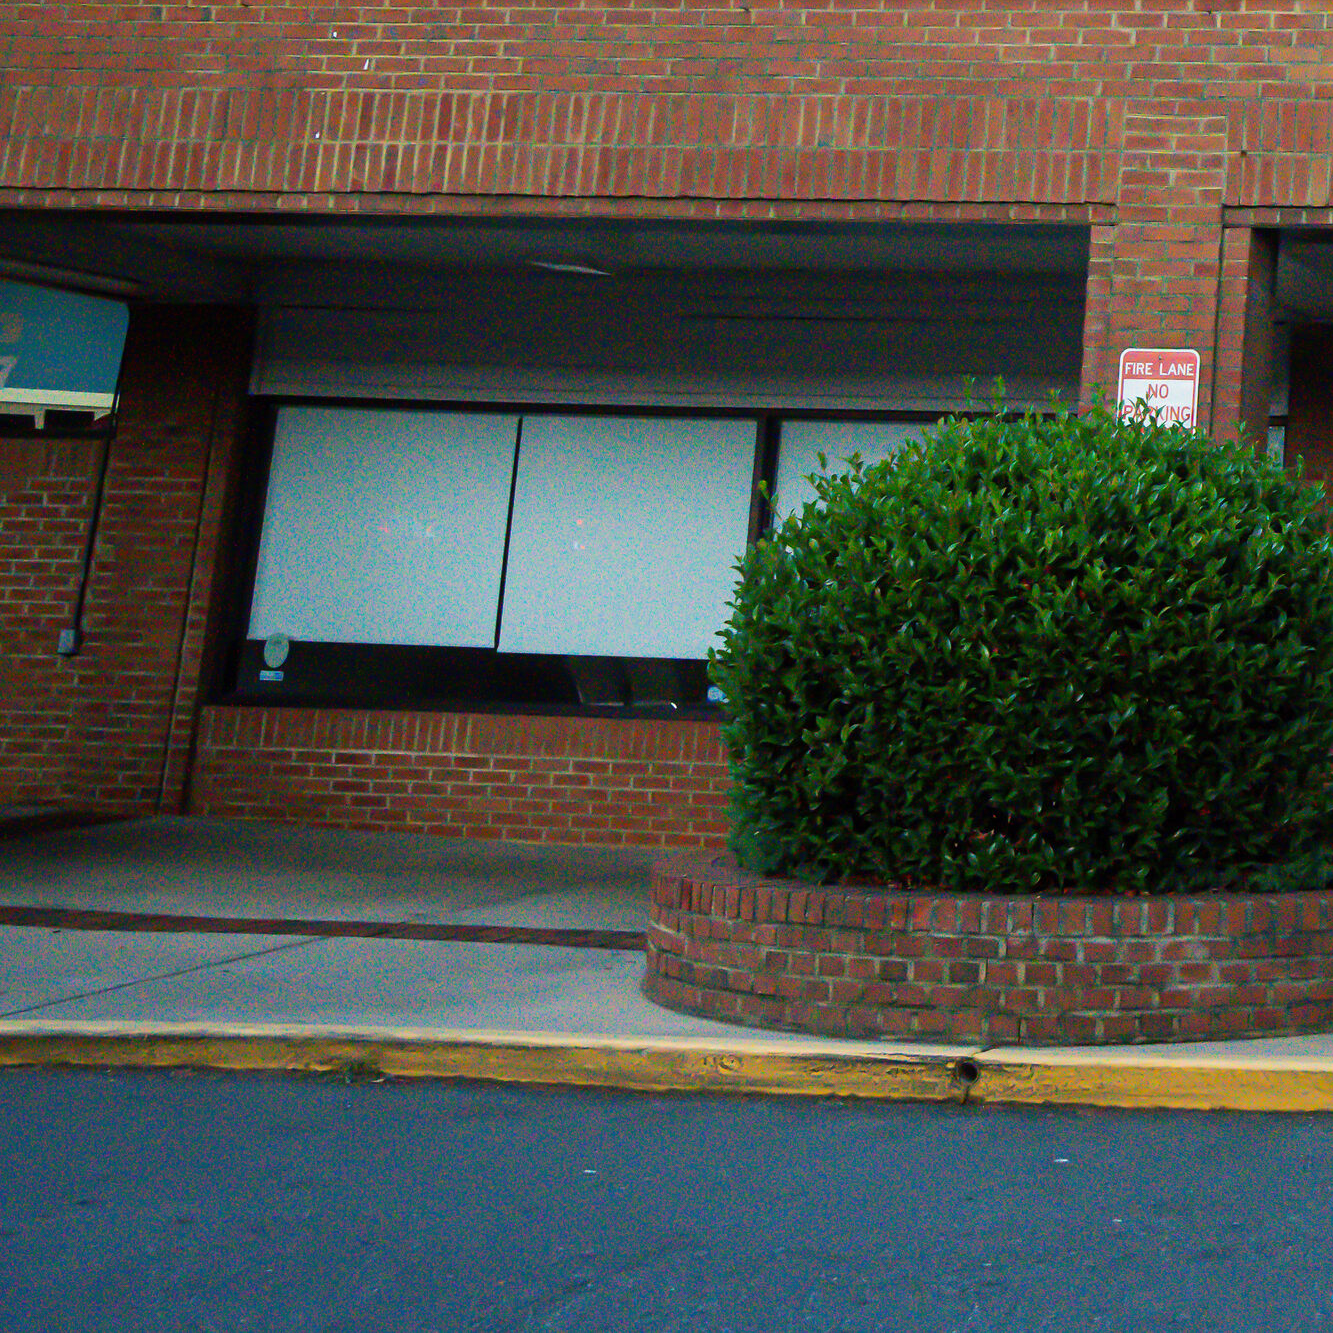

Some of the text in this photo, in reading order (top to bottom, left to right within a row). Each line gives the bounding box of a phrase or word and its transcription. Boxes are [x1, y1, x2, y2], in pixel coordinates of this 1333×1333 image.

[1124, 362, 1195, 376] FIRE LANE
[1147, 383, 1169, 399] NO
